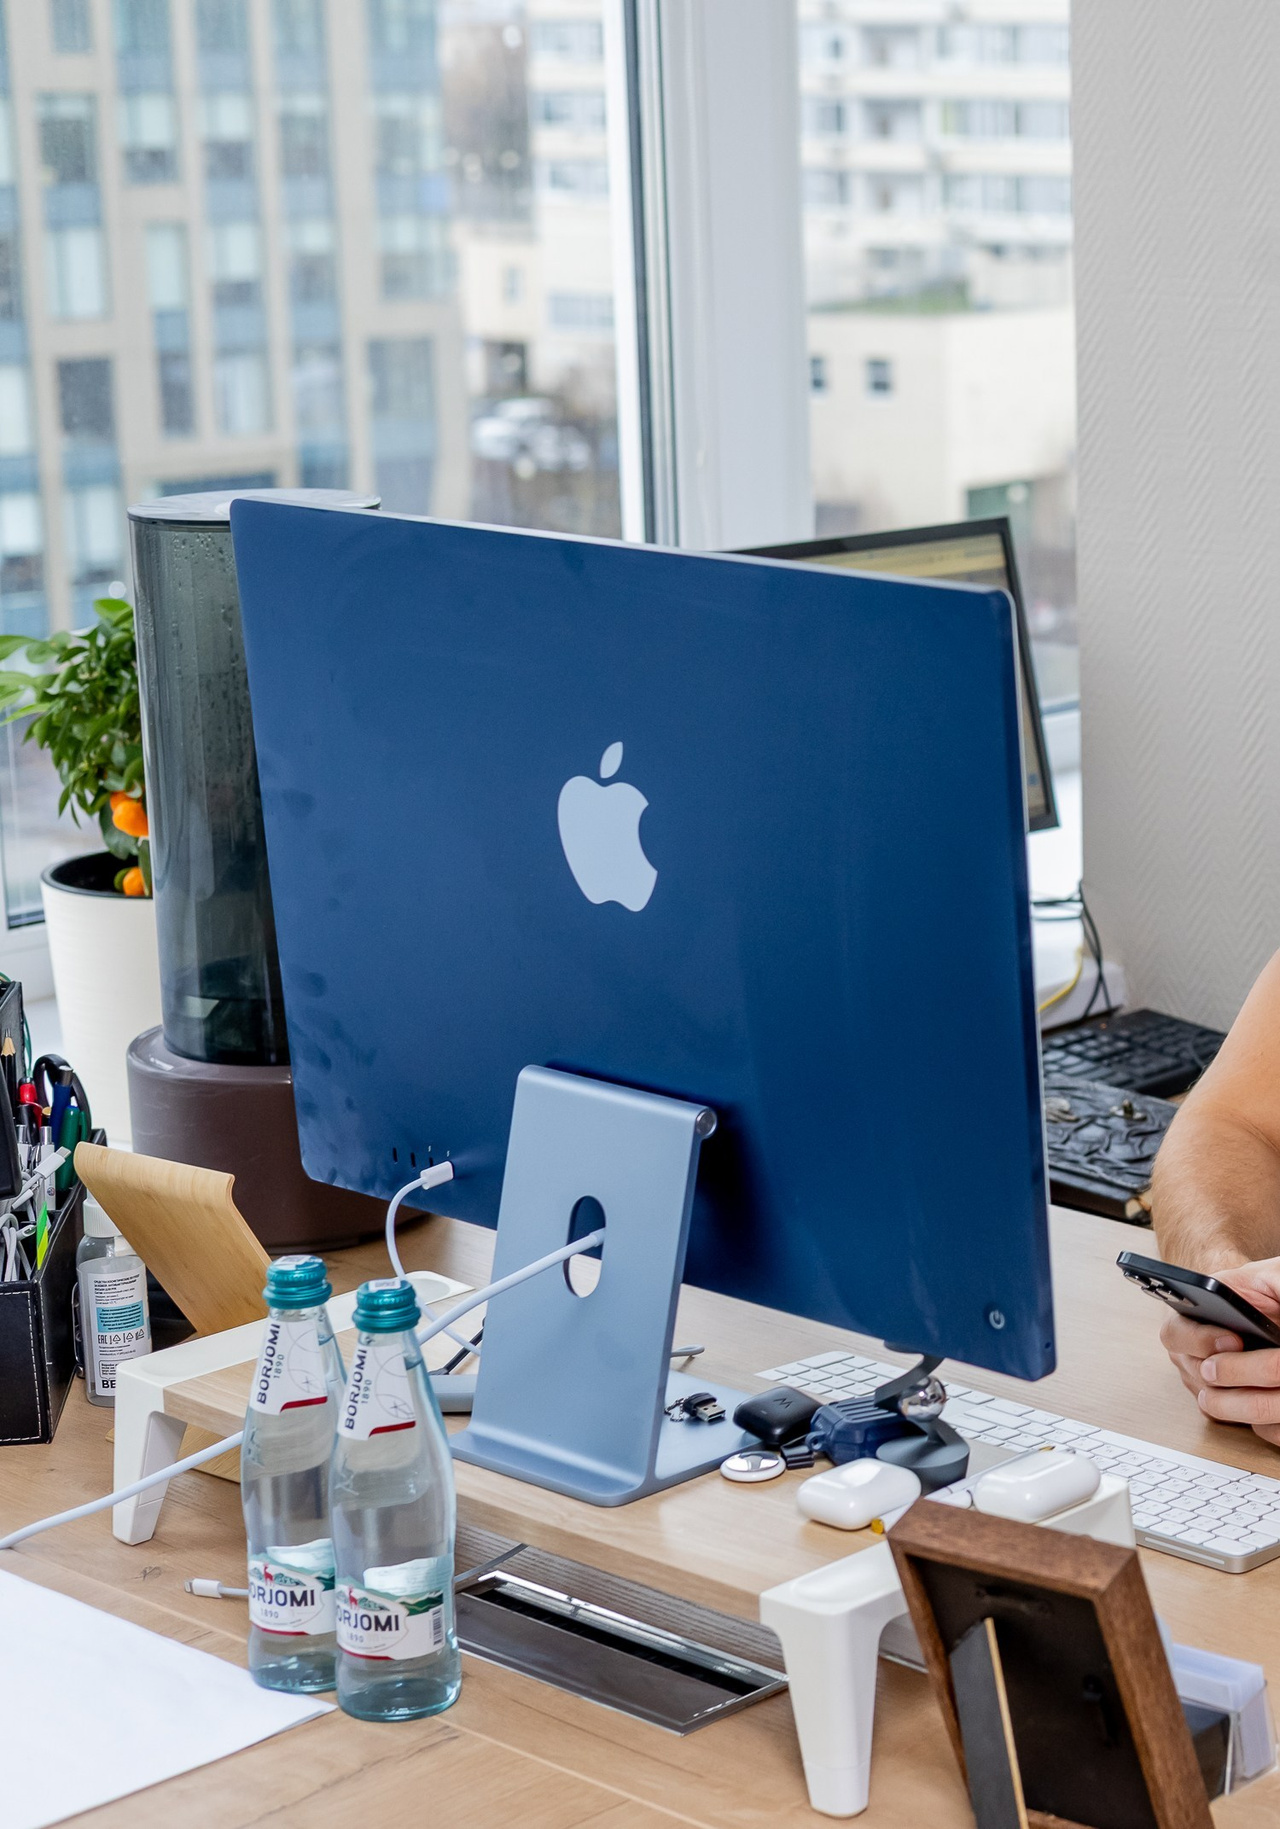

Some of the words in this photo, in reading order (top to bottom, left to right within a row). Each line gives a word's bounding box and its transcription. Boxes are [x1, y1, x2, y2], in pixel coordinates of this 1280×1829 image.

[257, 1323, 280, 1404] BORJOMI
[273, 1354, 285, 1378] 1890
[345, 1348, 367, 1430] BORJOMI
[361, 1379, 372, 1404] 1890
[249, 1581, 315, 1607] ORJOMI
[261, 1608, 279, 1619] 1890
[337, 1604, 399, 1632] ORJOMI
